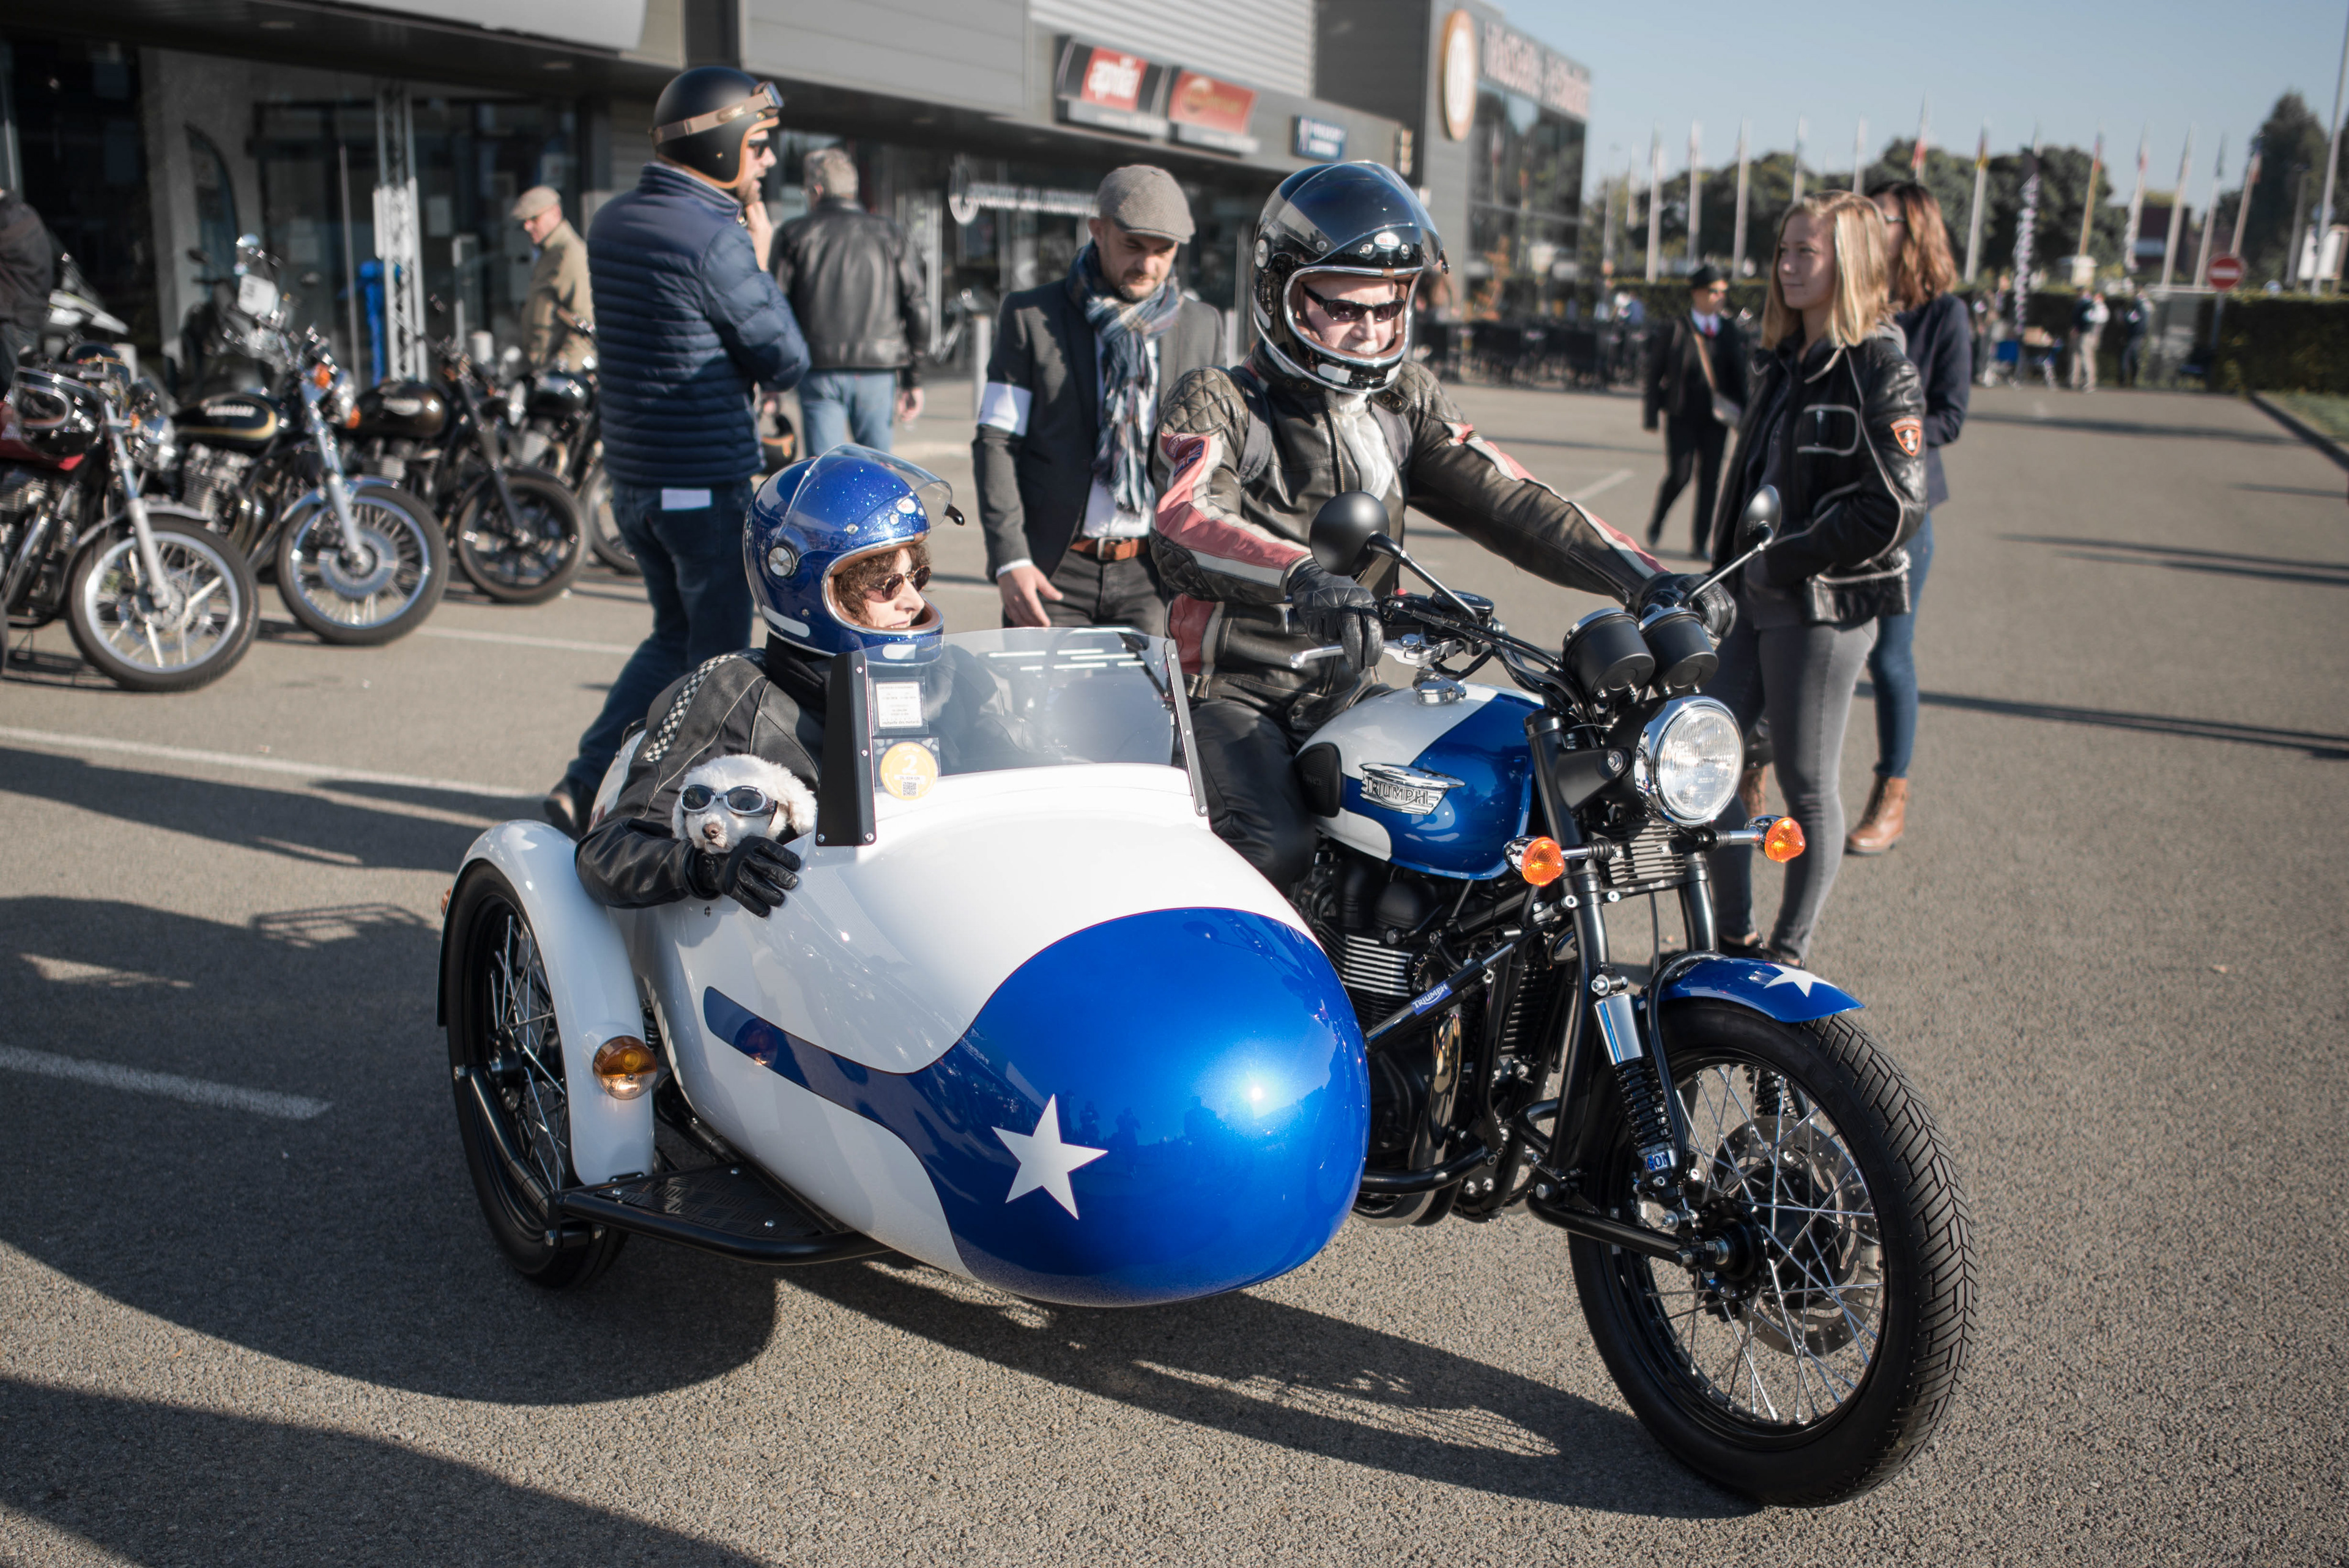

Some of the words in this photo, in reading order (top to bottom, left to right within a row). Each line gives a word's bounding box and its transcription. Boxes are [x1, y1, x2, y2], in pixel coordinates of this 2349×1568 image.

[902, 754, 918, 775] 2
[1365, 775, 1429, 806] TRIUMPH
[1412, 983, 1448, 1009] TRIUMPH
